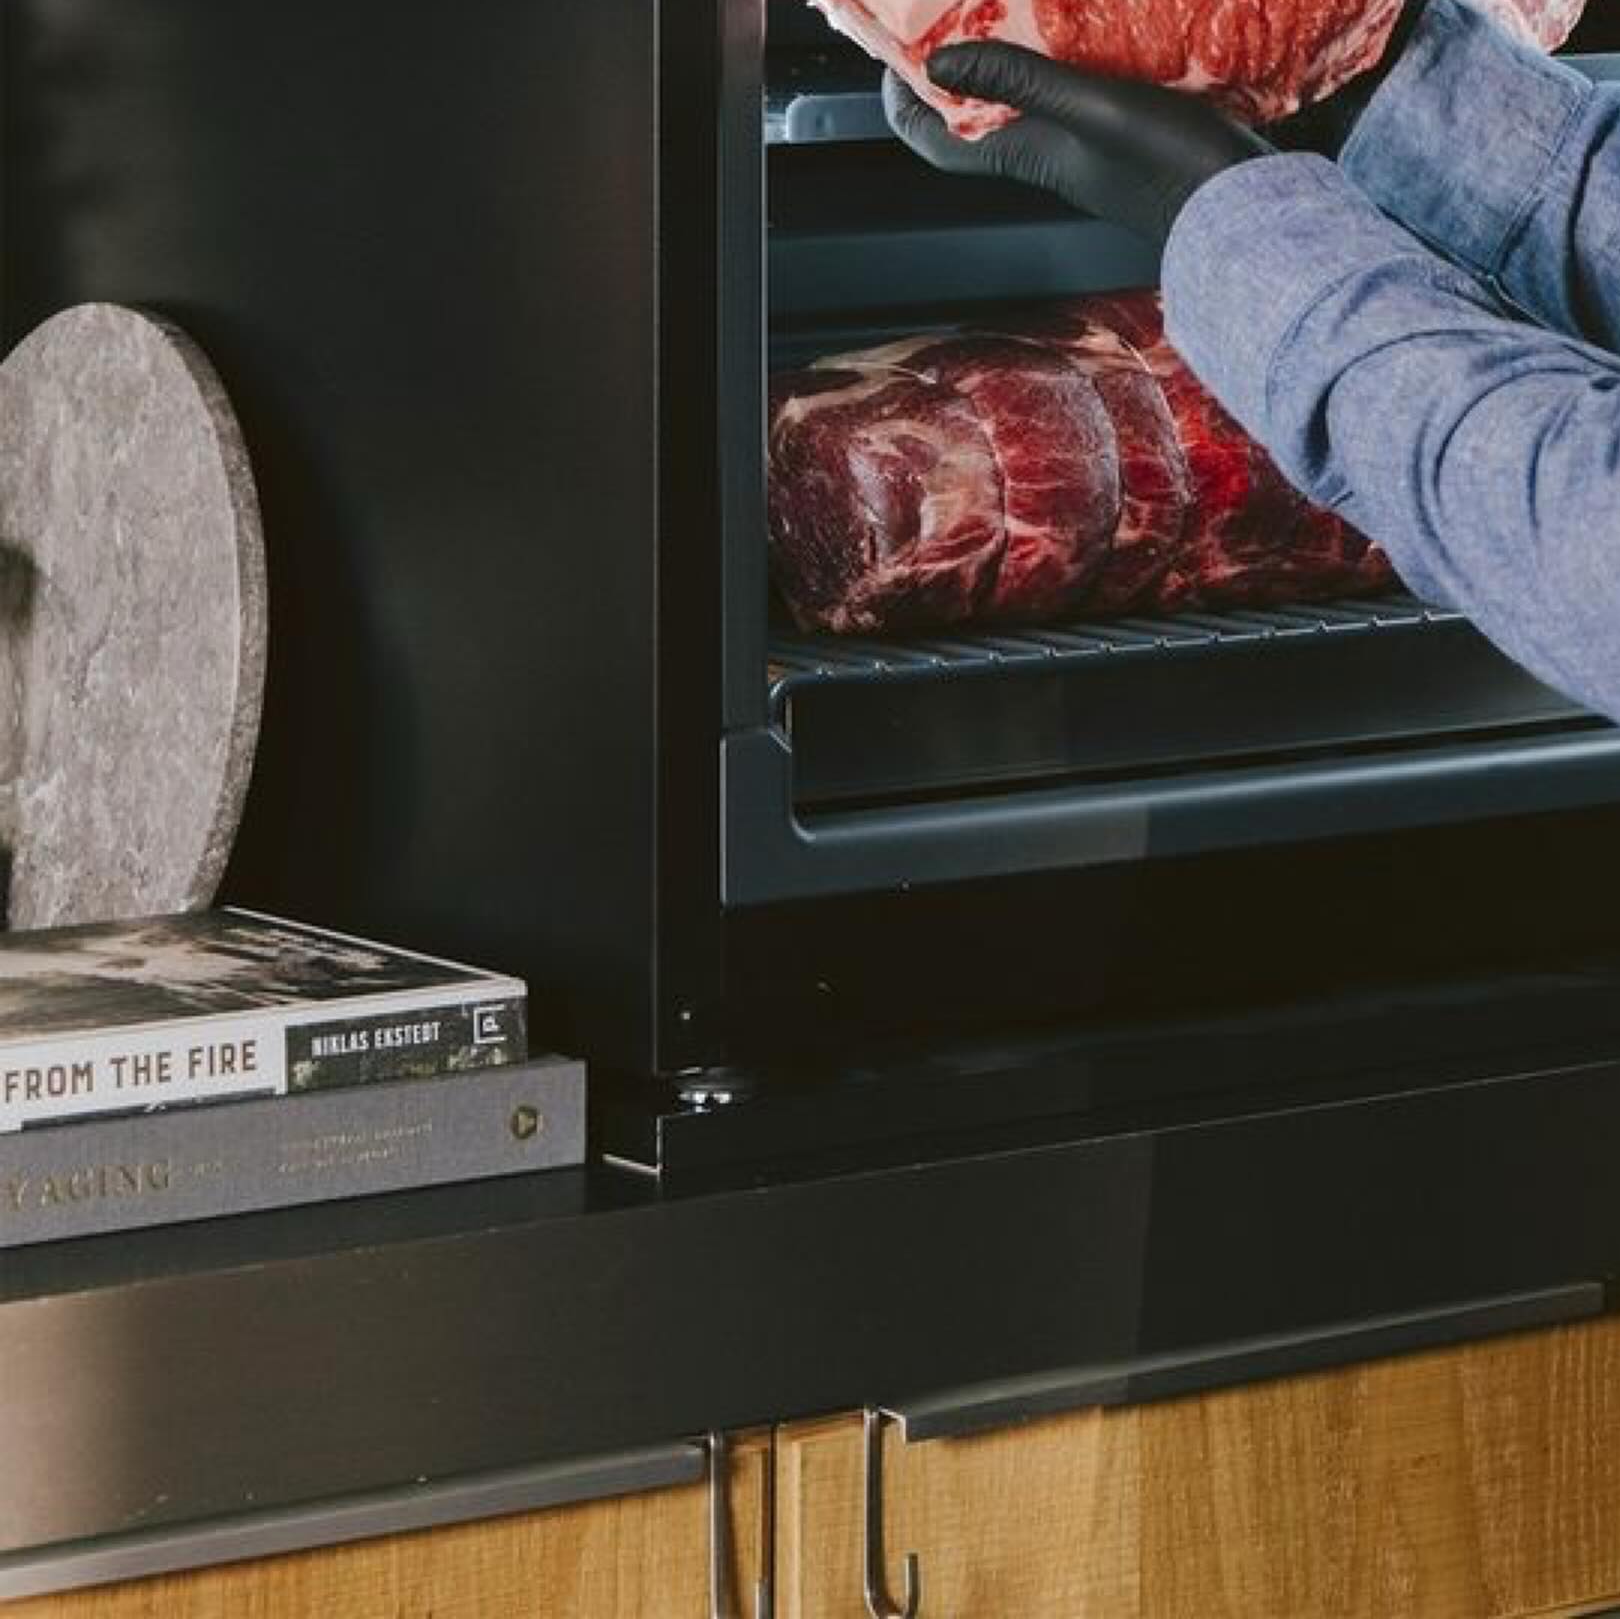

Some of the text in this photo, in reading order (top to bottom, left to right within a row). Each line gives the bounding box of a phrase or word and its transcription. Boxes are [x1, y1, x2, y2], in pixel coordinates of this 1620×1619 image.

[311, 1021, 442, 1057] NIKLAS EKSTEDT
[4, 1038, 258, 1104] FROM THE FIRE
[39, 1162, 170, 1205] AGING
